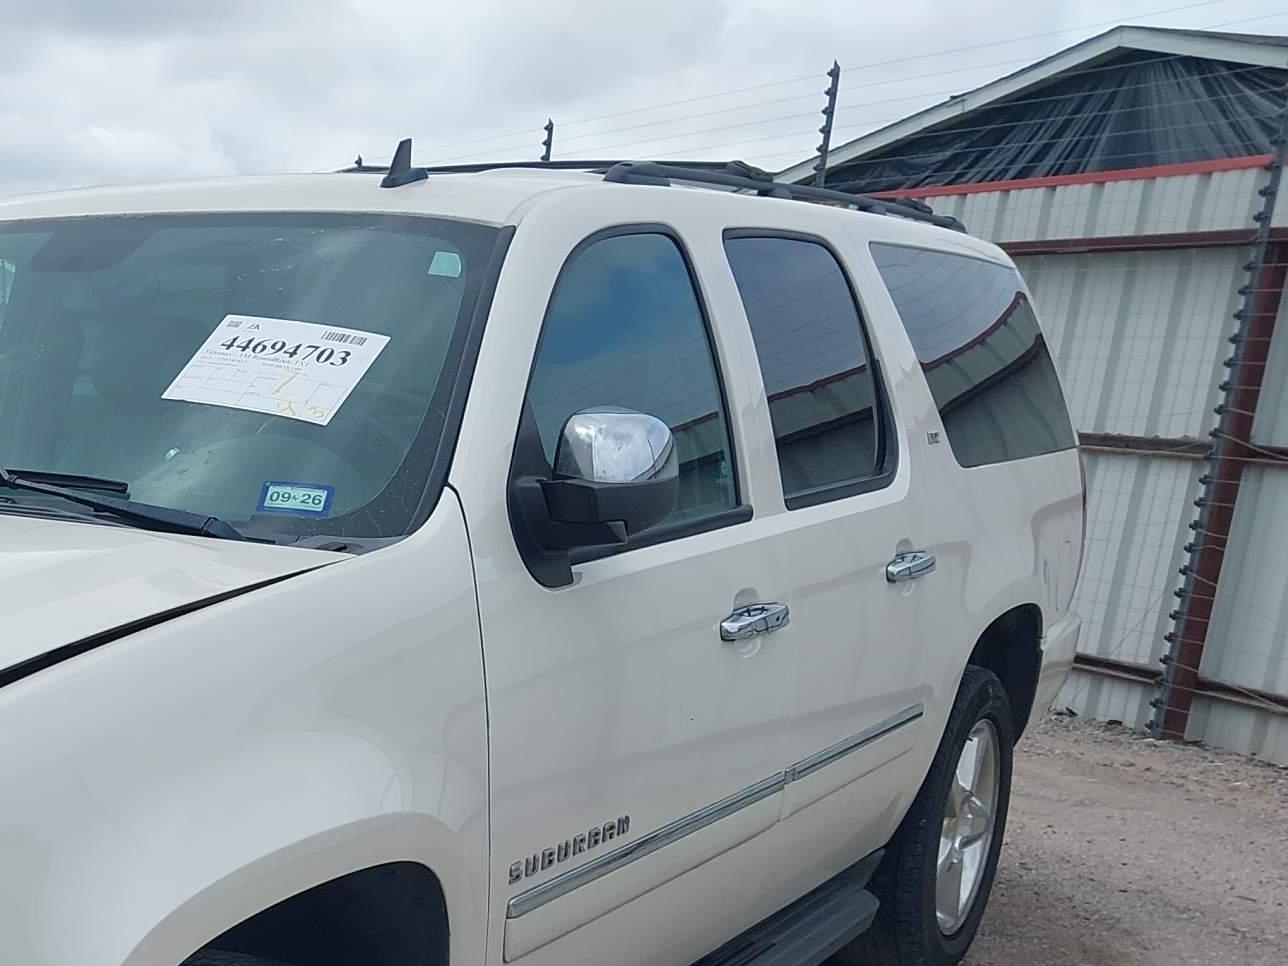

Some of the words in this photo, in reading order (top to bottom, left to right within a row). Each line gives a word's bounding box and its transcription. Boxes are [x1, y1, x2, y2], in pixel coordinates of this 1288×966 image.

[220, 335, 352, 368] 44694703
[269, 491, 292, 503] 09
[299, 493, 323, 506] 26
[508, 814, 630, 886] SUBURBAN
